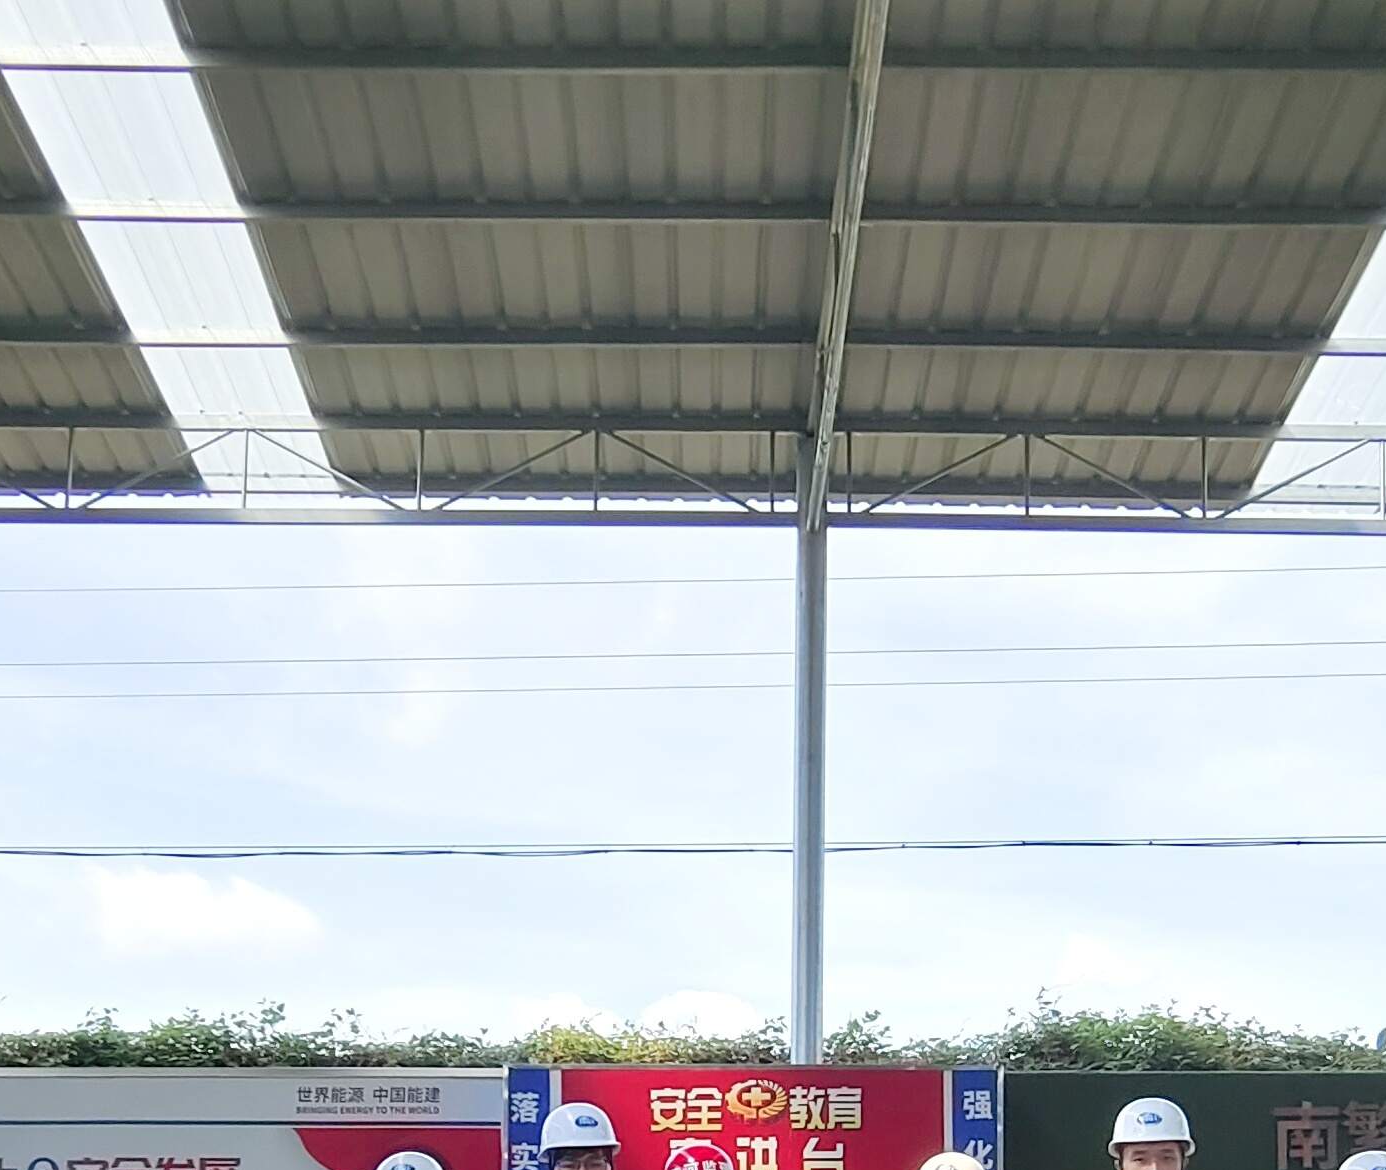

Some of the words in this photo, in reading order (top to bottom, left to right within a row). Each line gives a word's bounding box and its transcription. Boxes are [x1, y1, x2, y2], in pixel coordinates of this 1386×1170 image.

[297, 1086, 365, 1104] 世界能源
[372, 1086, 441, 1104] 中国能建
[649, 1086, 724, 1132] 安全
[789, 1085, 863, 1131] 教育
